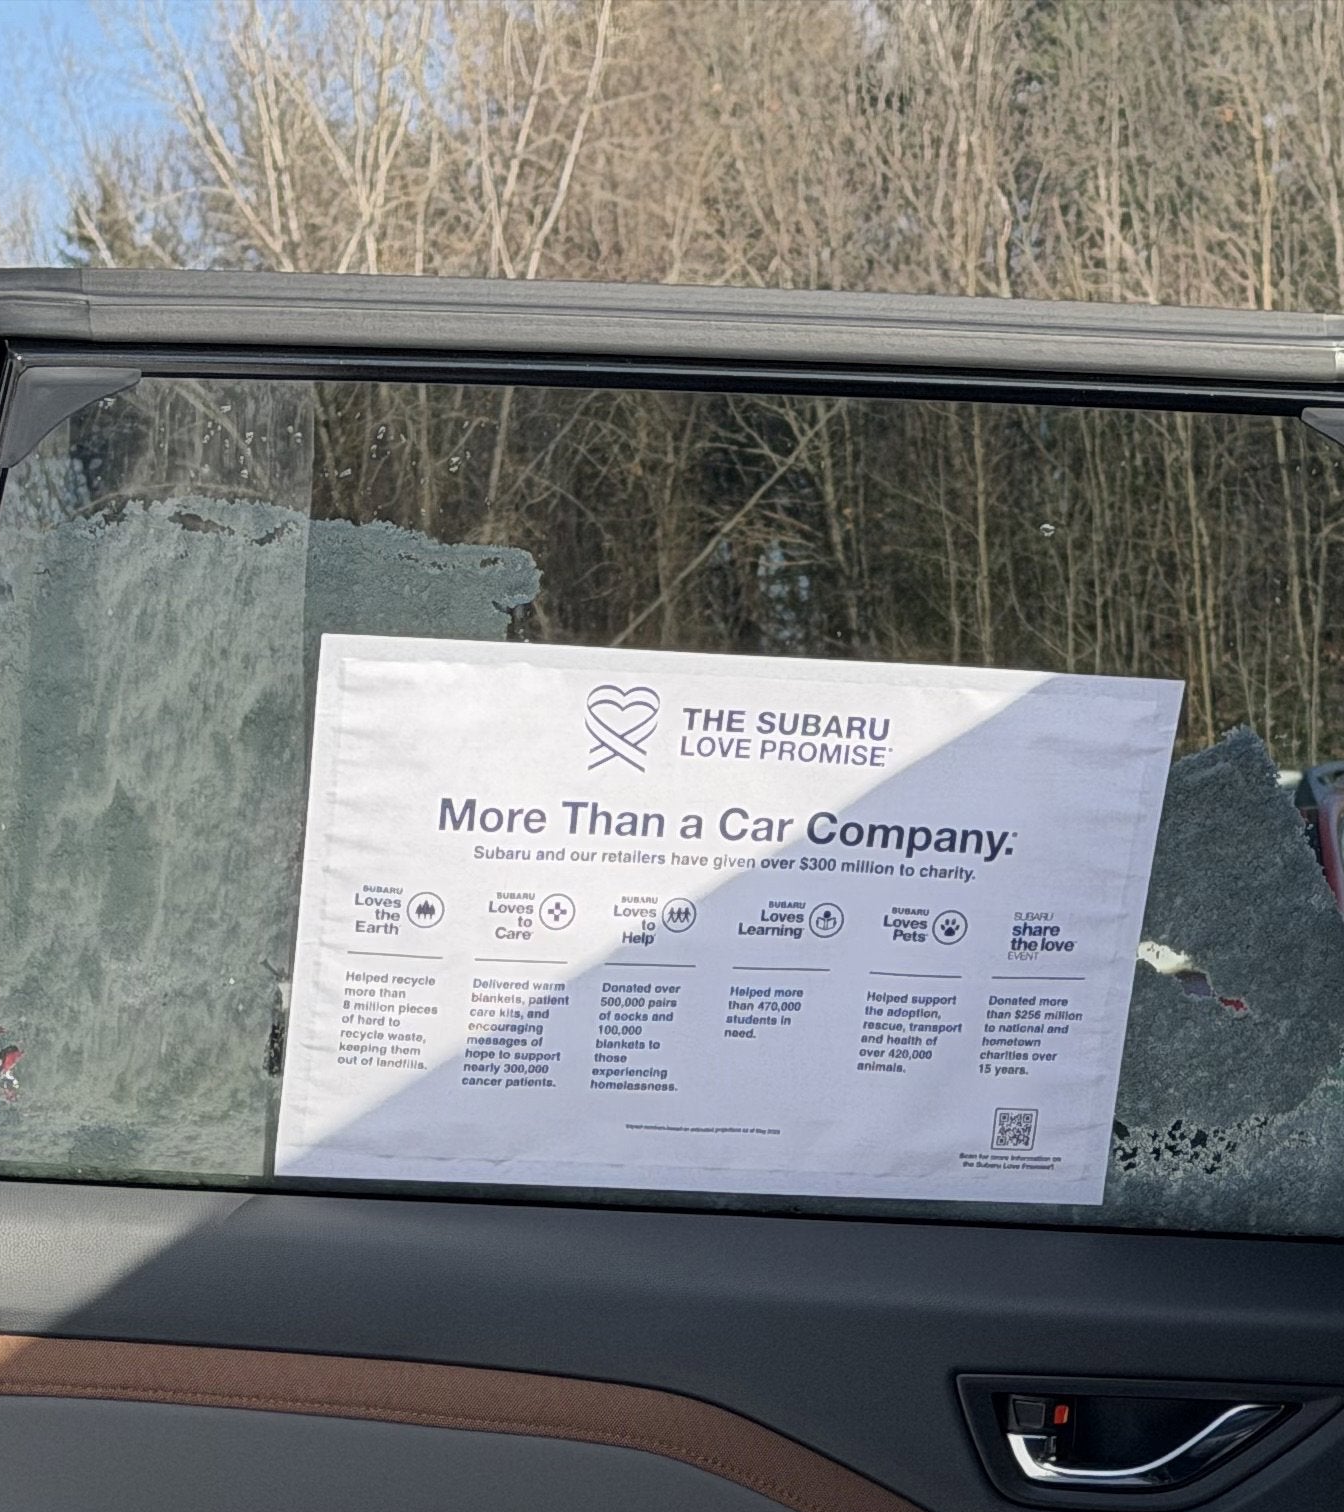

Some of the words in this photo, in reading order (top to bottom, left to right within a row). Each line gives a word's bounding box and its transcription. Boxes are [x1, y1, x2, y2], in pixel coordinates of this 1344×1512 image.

[682, 707, 746, 733] THE
[756, 711, 890, 741] SUBARU
[680, 735, 751, 759] LOVE
[438, 797, 546, 833] More
[561, 800, 664, 837] Than
[679, 814, 703, 839] a
[719, 807, 794, 842] Car
[473, 845, 531, 860] Subaru
[535, 847, 565, 861] and
[569, 850, 597, 861] our
[601, 850, 665, 865] retailers
[670, 852, 708, 866] have
[712, 854, 755, 870] given
[760, 858, 796, 869] over
[798, 856, 836, 871] $300
[840, 859, 894, 875] million
[899, 863, 915, 877] to
[919, 864, 975, 883] charity.
[362, 884, 403, 895] SUBARU
[496, 891, 535, 900] SUBARU
[354, 893, 401, 908] Loves
[621, 895, 658, 904] SUBARU
[768, 900, 806, 909] SUBARU
[488, 900, 534, 914] Loves
[613, 904, 656, 918] Loves
[891, 906, 929, 916] SUBARU
[374, 908, 400, 921] the
[517, 915, 532, 927] to
[760, 909, 804, 923] Loves
[1013, 911, 1054, 921] SUBARU
[355, 919, 399, 935] Earth
[641, 919, 656, 931] to
[883, 914, 927, 929] Loves
[494, 926, 532, 940] Care
[737, 922, 803, 939] Learning
[892, 929, 926, 943] Pets
[1012, 922, 1060, 938] share
[621, 931, 654, 946] Help
[1010, 936, 1038, 951] the
[1040, 936, 1074, 952] love
[1007, 950, 1039, 961] EVENT
[345, 970, 388, 984] Helped
[391, 975, 435, 987] recycle
[472, 978, 529, 990] Delivered
[532, 982, 565, 991] warm
[344, 987, 376, 997] more
[379, 987, 406, 998] than
[601, 982, 651, 993] Donated
[654, 985, 681, 993] over
[729, 986, 771, 999] Helped
[773, 989, 803, 997] more
[471, 992, 525, 1005] blankets,
[528, 994, 569, 1006] patient
[600, 996, 645, 1008] 500,000
[647, 997, 677, 1009] pairs
[866, 990, 908, 1005] Helped
[911, 995, 956, 1007] support
[988, 995, 1036, 1006] Donated
[1038, 998, 1068, 1006] more
[342, 999, 350, 1009] 8
[353, 1001, 394, 1012] million
[398, 1002, 438, 1015] pieces
[728, 1000, 754, 1011] than
[757, 1001, 802, 1012] 470,000
[864, 1005, 883, 1016] the
[886, 1007, 941, 1020] adoption,
[341, 1013, 354, 1024] of
[357, 1014, 385, 1026] hard
[388, 1016, 400, 1027] to
[469, 1008, 495, 1017] care
[499, 1008, 523, 1020] kits,
[526, 1008, 549, 1019] and
[598, 1010, 611, 1021] of
[613, 1011, 648, 1021] socks
[651, 1011, 674, 1022] and
[725, 1014, 777, 1025] students
[780, 1015, 791, 1025] in
[986, 1009, 1011, 1019] than
[1014, 1009, 1041, 1020] $256
[1043, 1010, 1083, 1021] million
[467, 1022, 543, 1035] encouraging
[598, 1024, 642, 1036] 100,000
[724, 1028, 756, 1038] need.
[862, 1020, 905, 1032] rescue,
[908, 1022, 962, 1034] transport
[983, 1023, 995, 1032] to
[998, 1023, 1044, 1033] national
[1046, 1024, 1069, 1034] and
[340, 1029, 384, 1041] recycle
[387, 1032, 426, 1044] waste,
[466, 1036, 527, 1048] messages
[530, 1036, 543, 1047] of
[860, 1033, 884, 1044] and
[886, 1034, 922, 1046] health
[925, 1035, 938, 1046] of
[981, 1036, 1041, 1047] hometown
[338, 1041, 387, 1056] keeping
[390, 1044, 420, 1055] them
[595, 1038, 645, 1049] blankets
[648, 1039, 660, 1049] to
[464, 1048, 495, 1060] hope
[498, 1049, 511, 1059] to
[513, 1051, 561, 1062] support
[594, 1052, 627, 1063] those
[858, 1048, 885, 1057] over
[887, 1048, 932, 1060] 420,000
[979, 1049, 1028, 1060] charities
[1031, 1052, 1057, 1061] over
[337, 1055, 357, 1065] out
[360, 1056, 373, 1066] of
[376, 1057, 427, 1070] landfills.
[463, 1062, 500, 1075] nearly
[503, 1063, 549, 1074] 300,000
[856, 1060, 906, 1073] animals.
[591, 1066, 668, 1080] experiencing
[978, 1063, 991, 1074] 15
[994, 1065, 1028, 1076] years.
[461, 1077, 502, 1086] cancer
[504, 1076, 555, 1088] patients.
[589, 1078, 677, 1091] homelessness.
